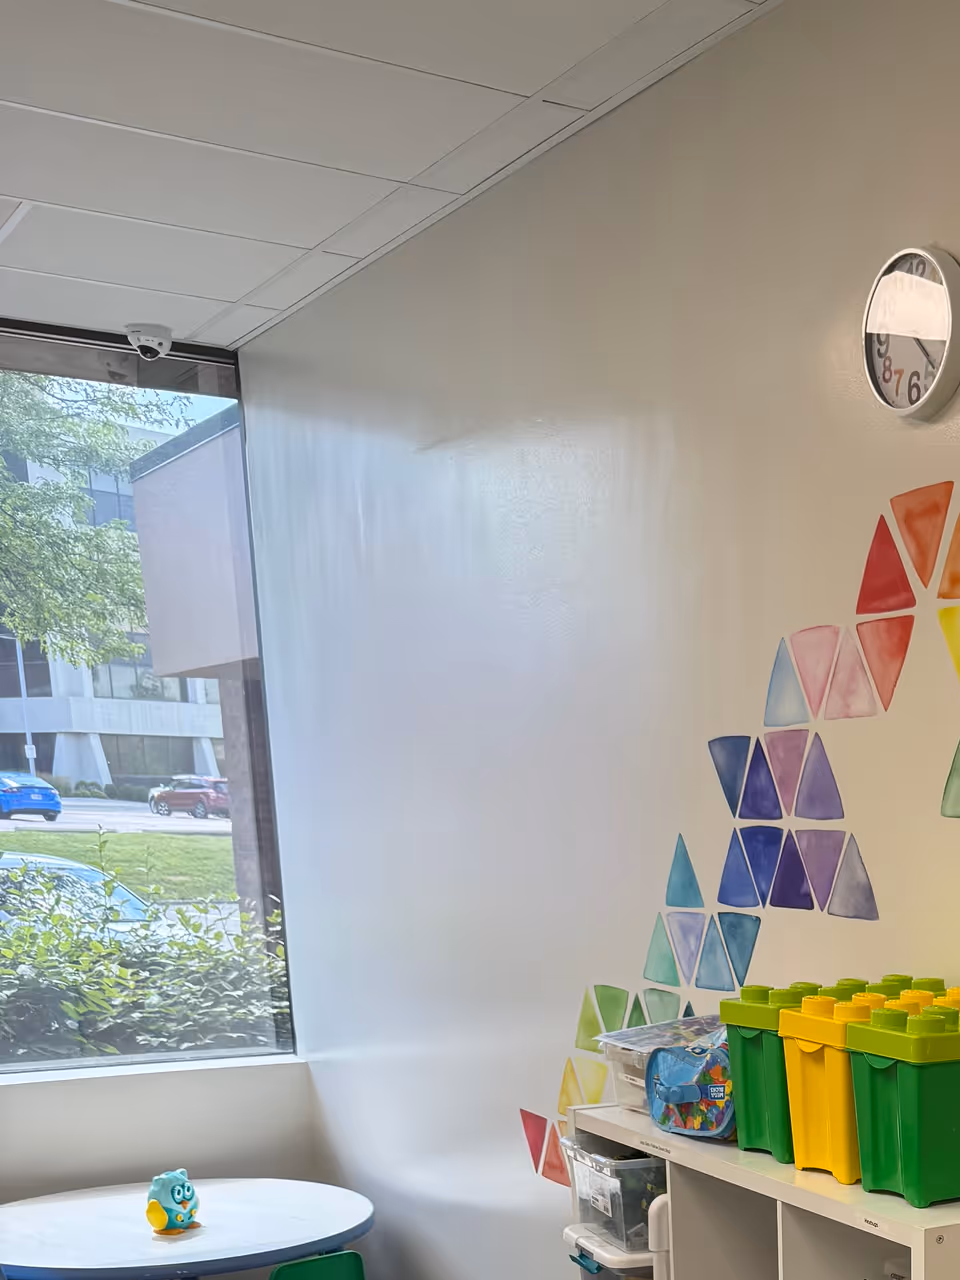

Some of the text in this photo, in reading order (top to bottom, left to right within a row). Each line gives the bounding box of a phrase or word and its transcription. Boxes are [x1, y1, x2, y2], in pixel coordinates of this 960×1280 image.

[877, 326, 890, 358] 9
[882, 355, 893, 384] 8
[893, 368, 904, 397] 7
[907, 370, 921, 405] 6
